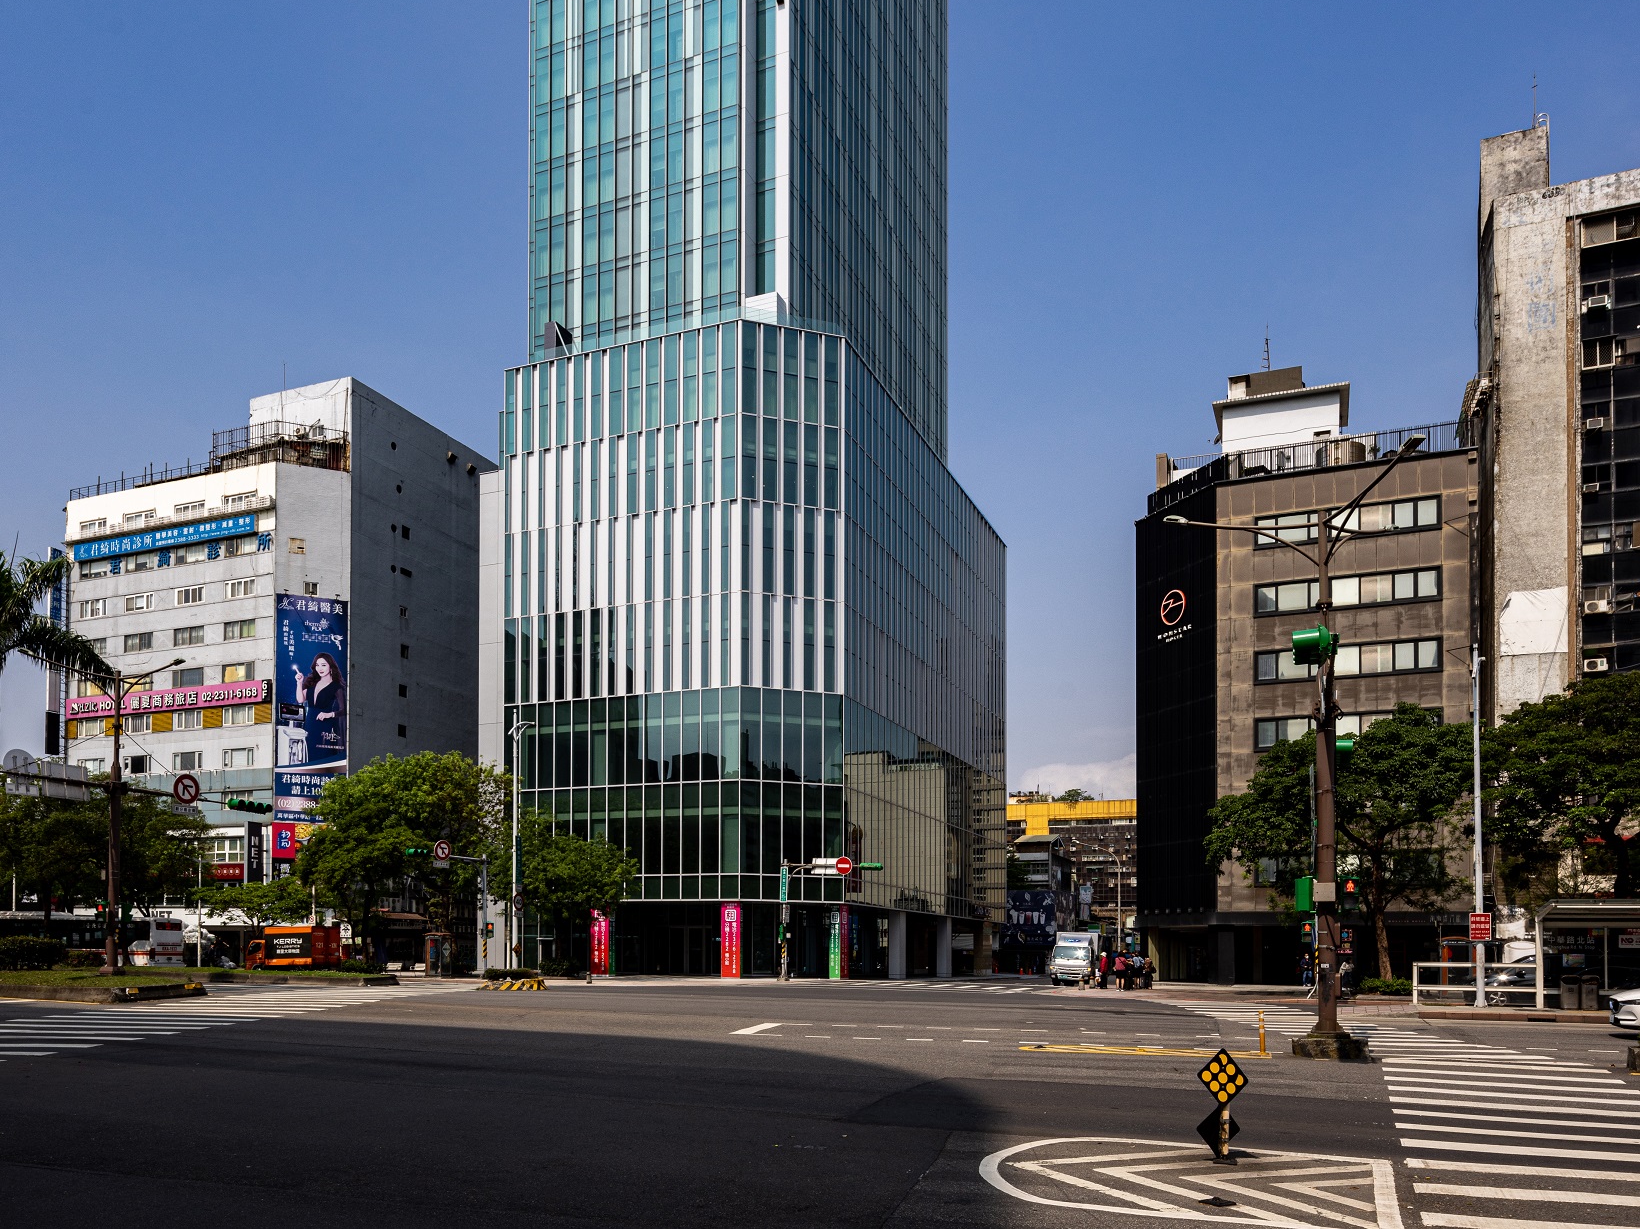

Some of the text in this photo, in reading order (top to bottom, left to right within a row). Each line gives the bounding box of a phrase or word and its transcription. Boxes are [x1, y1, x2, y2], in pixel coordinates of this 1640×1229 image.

[90, 534, 154, 556] 君綺時尚診所
[295, 599, 343, 615] 君綺醫美
[100, 700, 126, 711] HOTL
[130, 691, 198, 710] 儷夏商務旅店
[201, 687, 257, 701] 02-2311-6168
[251, 836, 259, 869] NET
[151, 910, 173, 918] NET
[1547, 935, 1595, 944] 中華路北站
